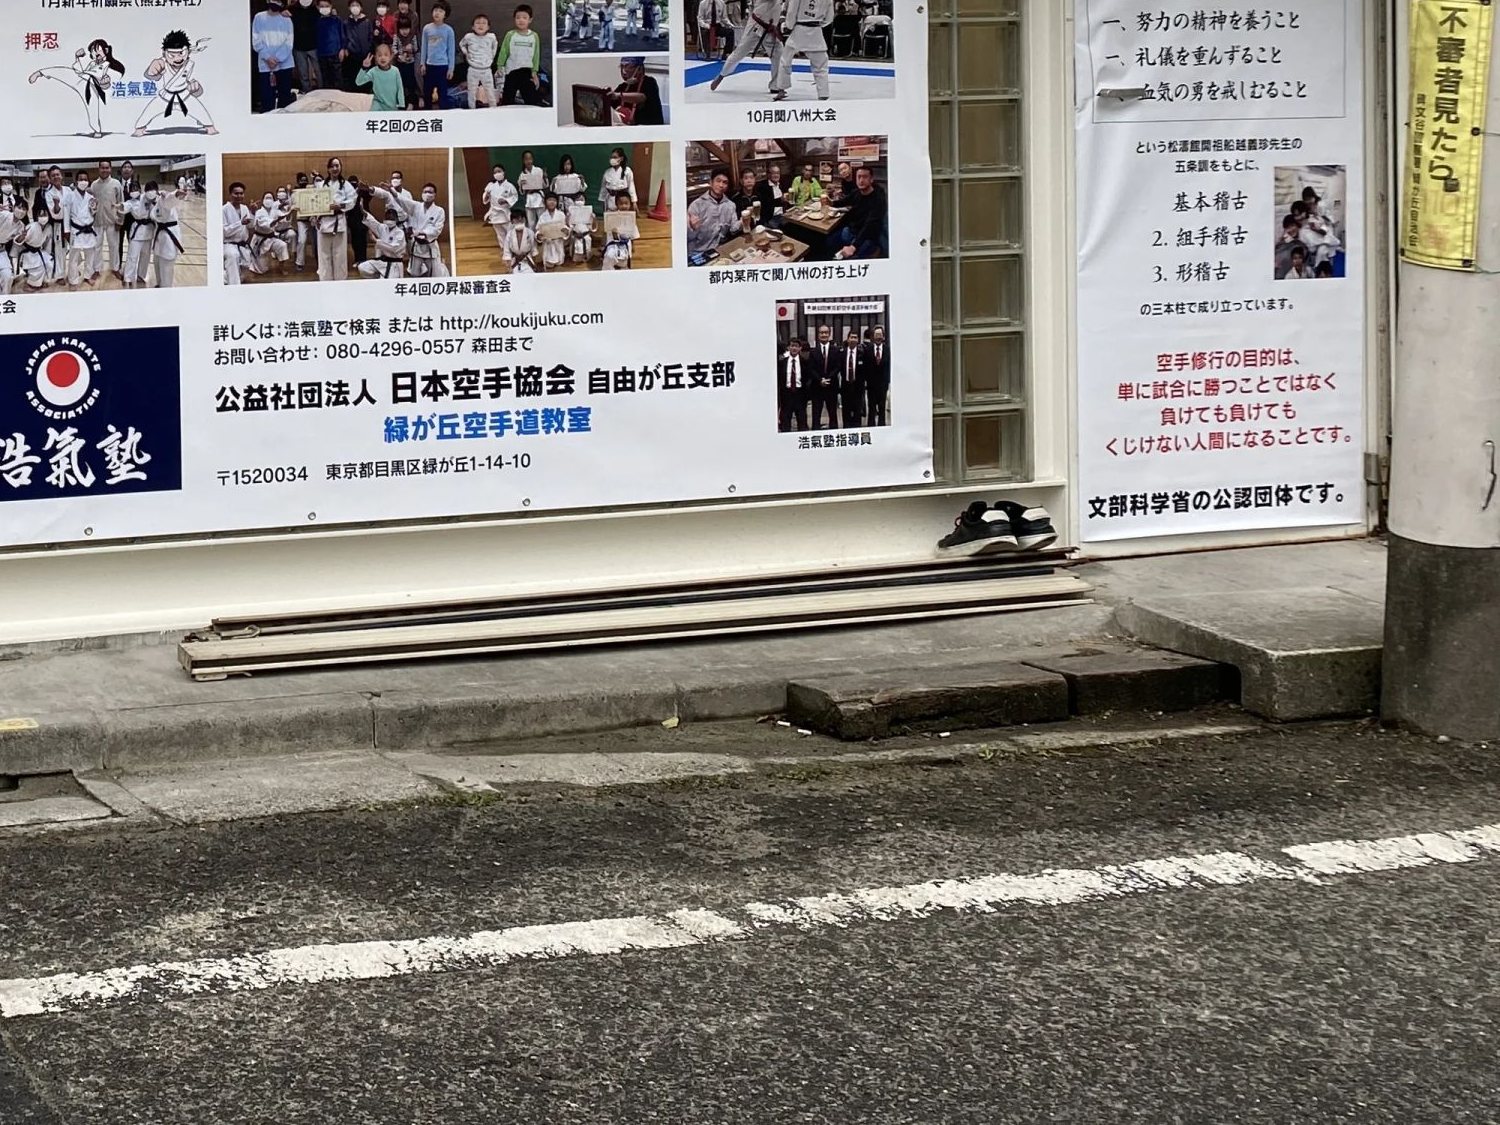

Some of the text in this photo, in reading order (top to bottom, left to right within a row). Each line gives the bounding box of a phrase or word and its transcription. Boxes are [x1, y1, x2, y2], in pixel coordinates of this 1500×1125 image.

[1102, 11, 1300, 33] 一、努力の精神を養うこと
[24, 32, 60, 50] 押忍
[1105, 45, 1282, 67] 一、礼儀を重んずること
[111, 81, 158, 98] 浩氣塾
[1096, 82, 1307, 103] 、血気の勇を戒しむること
[1428, 6, 1468, 180] 不審者見たら
[365, 118, 444, 135] 年2回の合宿
[746, 108, 837, 124] 10月関八州大会
[1175, 159, 1260, 173] 五条訓をもとに、
[1172, 190, 1248, 212] 基本稽古
[1152, 226, 1249, 247] 2. 組手稽古
[709, 264, 870, 284] 都内某所で関八州の打ち上げ
[1152, 261, 1230, 283] 3. 形稽古
[394, 279, 512, 297] 年4回の昇級審査会
[1140, 298, 1294, 316] の三本柱で成り立っています。
[388, 315, 434, 333] または
[439, 309, 604, 333] http://koukijuku.com
[25, 337, 102, 375] JAPAN KARATE
[214, 336, 534, 366] お問い合わせ: 080-4296-0557 森田まで
[1156, 348, 1300, 372] 空手修行の目的は、
[215, 361, 736, 413] 公益社団法人 日本空手協会 自由が丘支部
[1117, 372, 1336, 401] 単に試合に勝つことではなく
[25, 388, 101, 420] ASSOCIATION
[1160, 401, 1297, 426] 負けても負けても
[384, 407, 592, 444] 緑が丘空手道教室
[798, 432, 873, 450] 浩氣塾指導員
[1105, 425, 1352, 456] くじけない人間になることです。
[325, 453, 531, 481] 東京都目黒区緑が丘1-14-10
[1088, 481, 1344, 519] 文部科学省の公認団体です。
